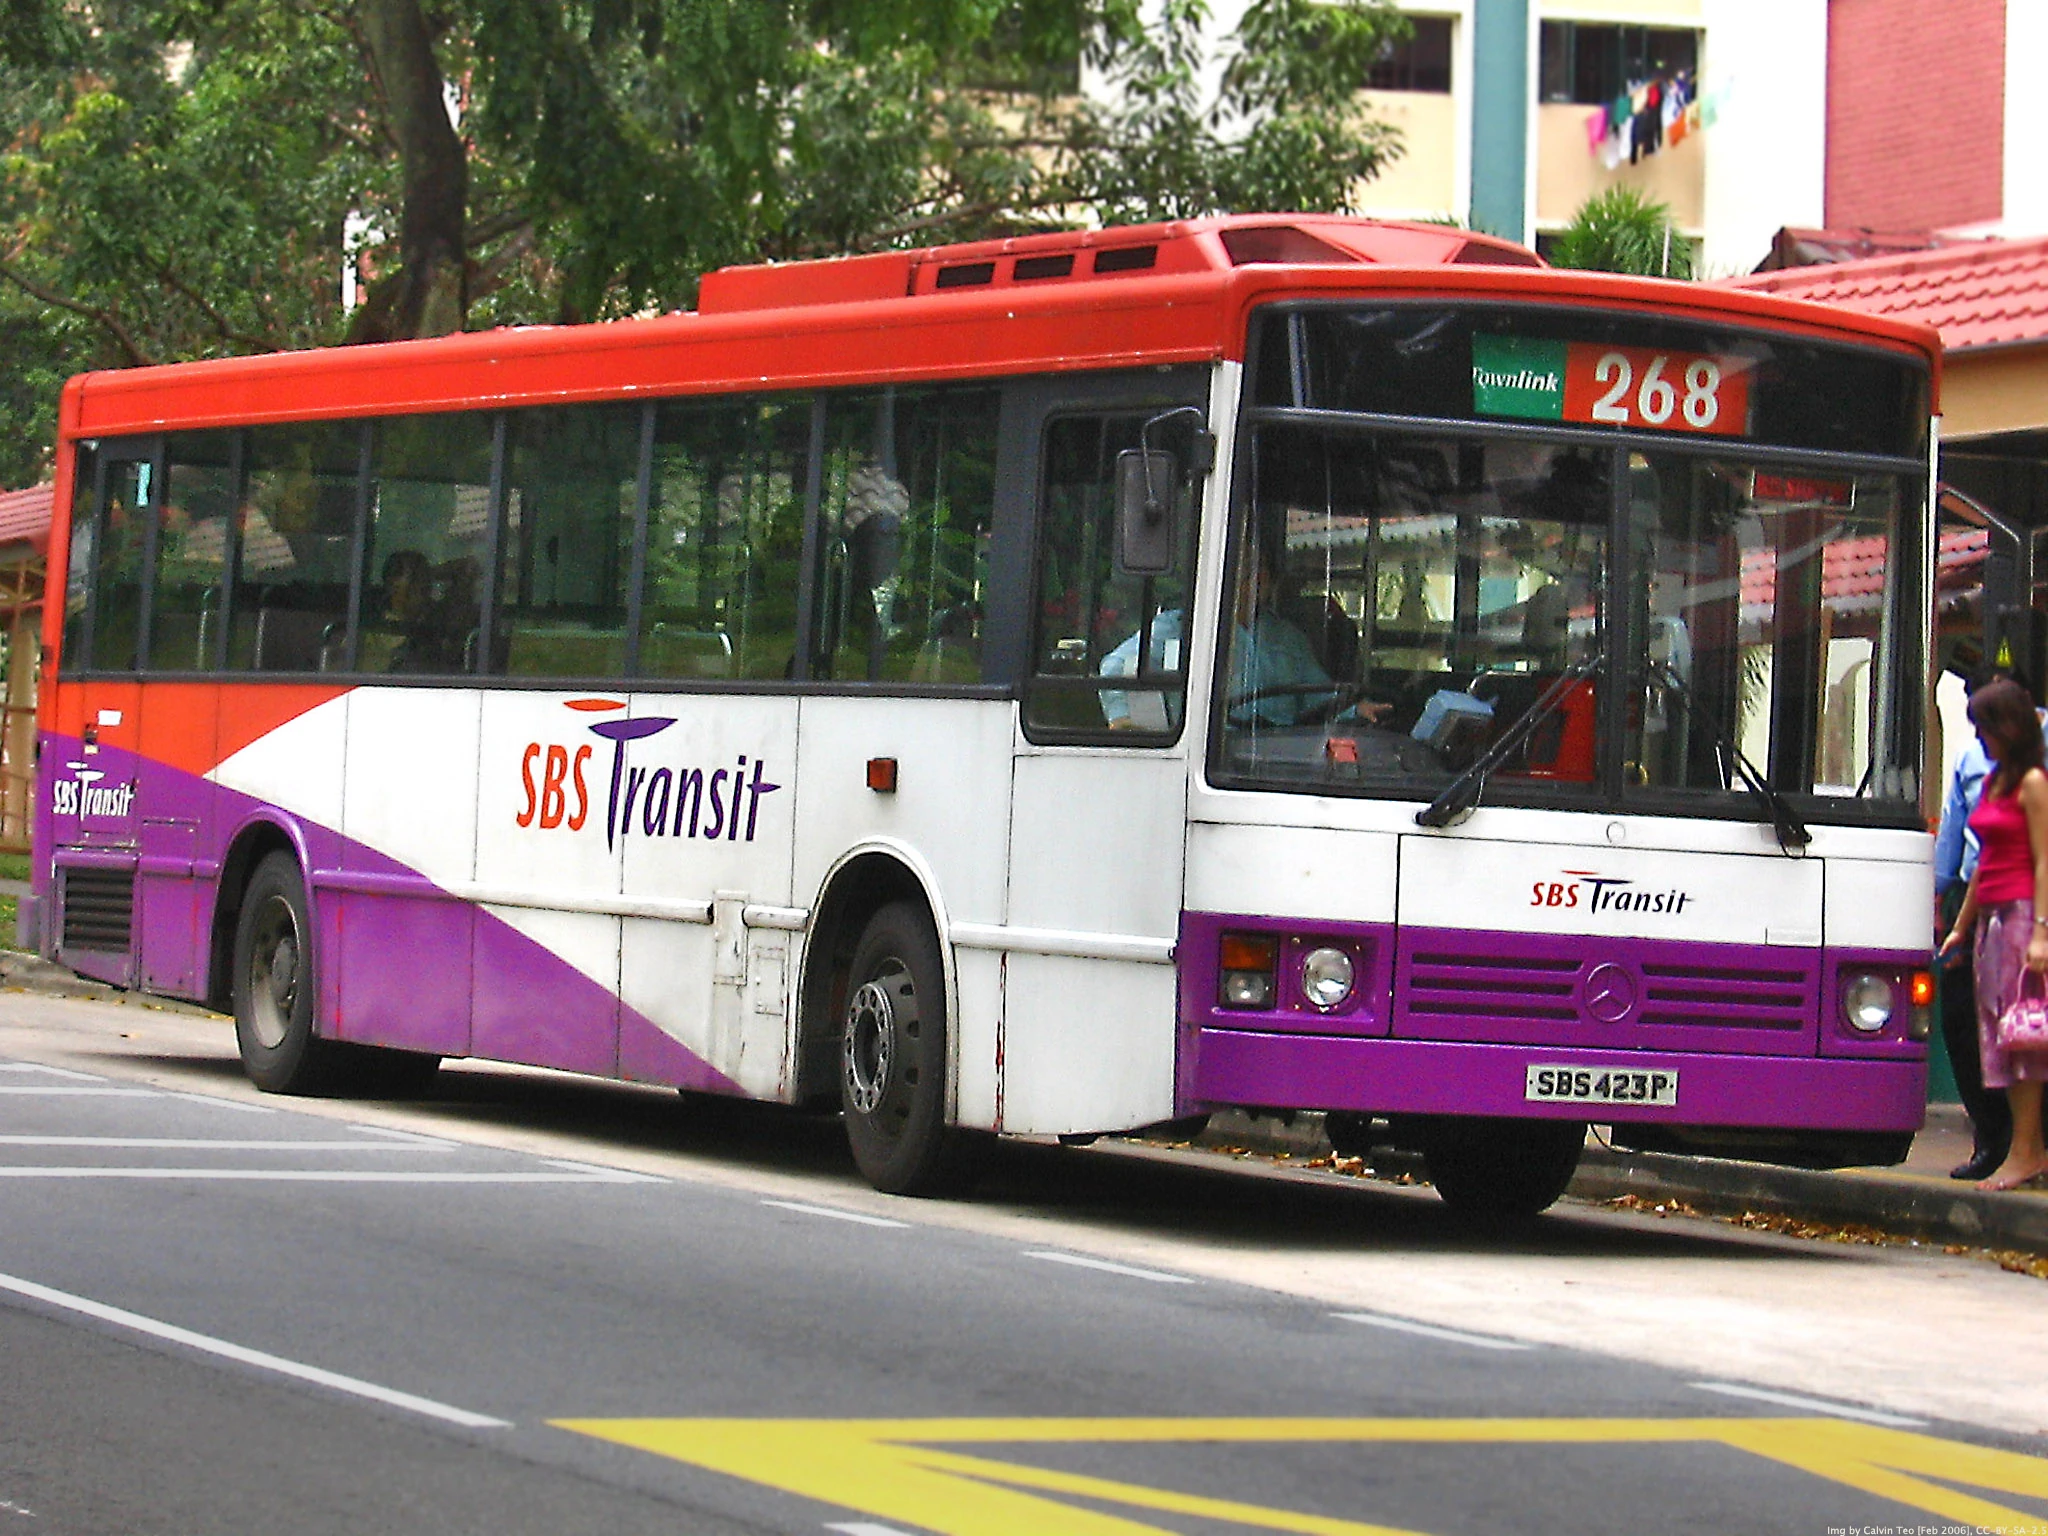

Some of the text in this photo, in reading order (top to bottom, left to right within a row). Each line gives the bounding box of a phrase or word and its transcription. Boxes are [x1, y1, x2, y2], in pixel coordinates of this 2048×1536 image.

[1592, 352, 1721, 428] 268
[53, 771, 135, 821] SBS Transit
[516, 717, 781, 854] SBS Transit
[1531, 878, 1696, 915] SBS Transit
